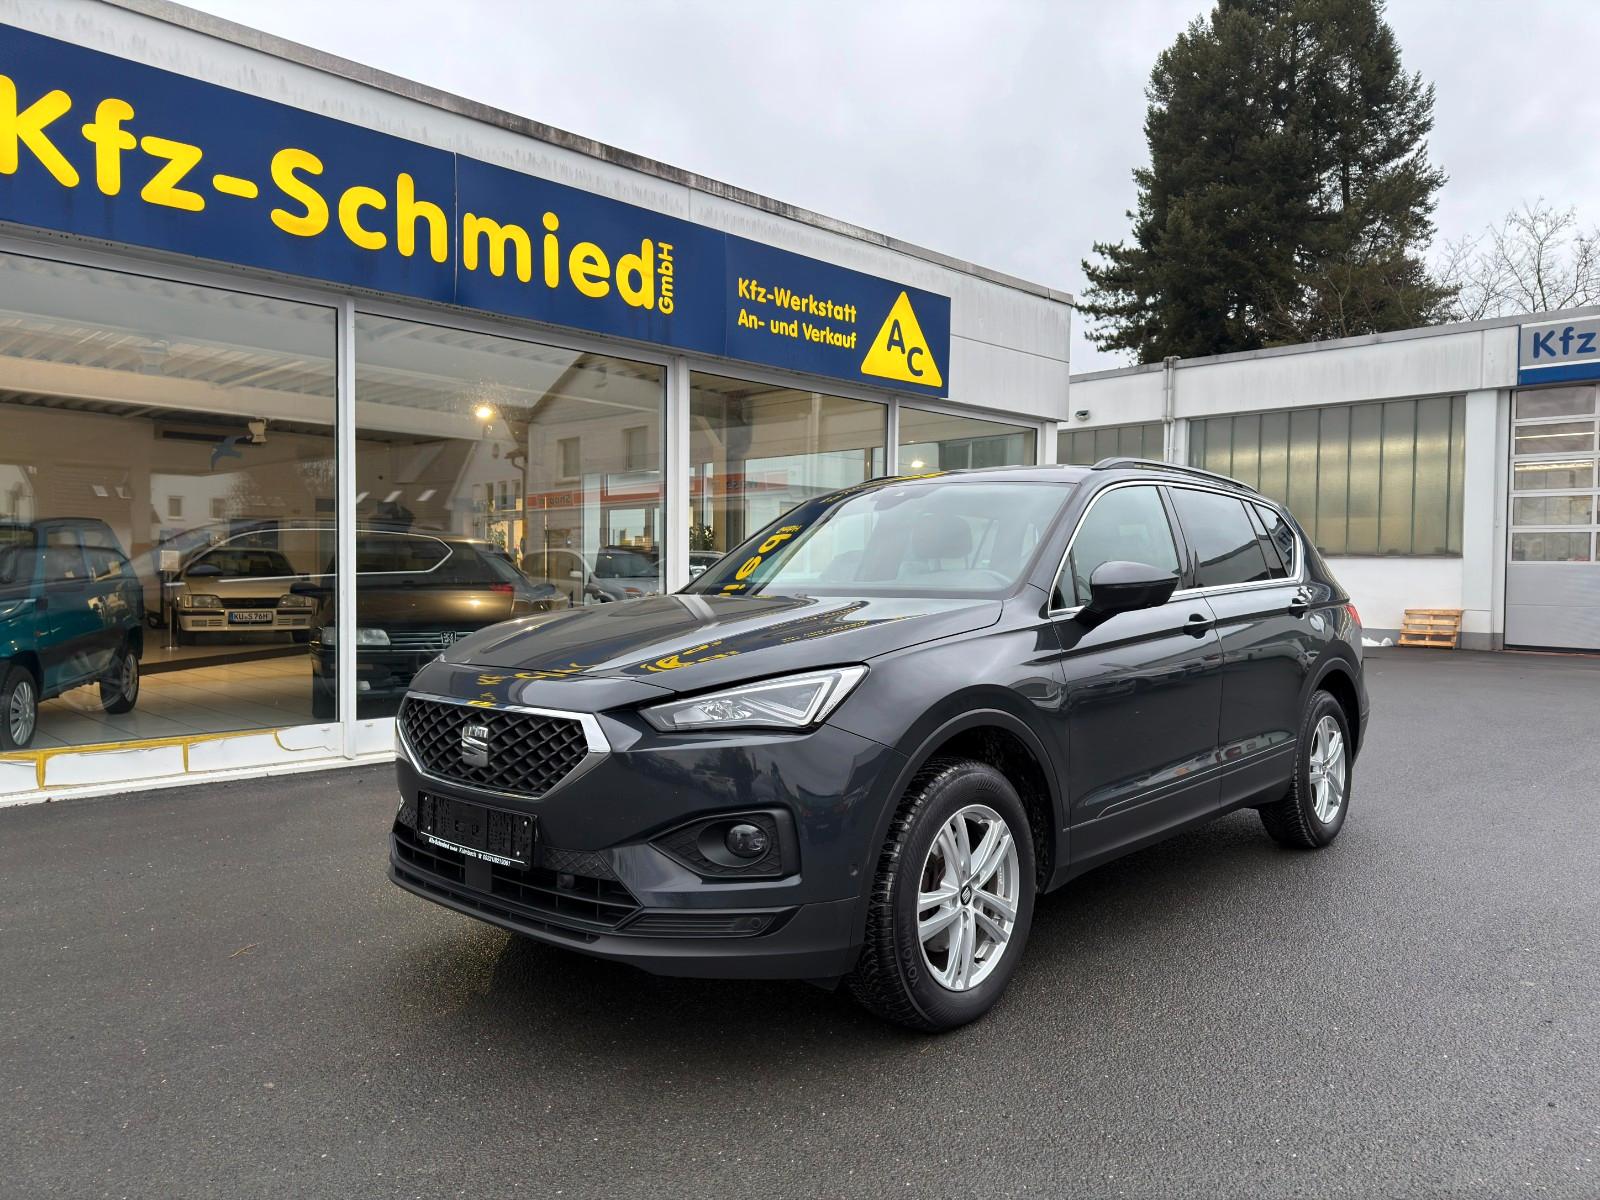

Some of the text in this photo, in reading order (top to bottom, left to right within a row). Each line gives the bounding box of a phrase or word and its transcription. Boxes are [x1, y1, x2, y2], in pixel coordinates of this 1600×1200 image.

[0, 75, 654, 311] Kfz-Schmied
[658, 242, 674, 315] GmbH
[738, 277, 857, 324] Kfz-Werkstatt
[738, 308, 857, 349] An- und Verkauf
[1533, 326, 1597, 359] Kfz
